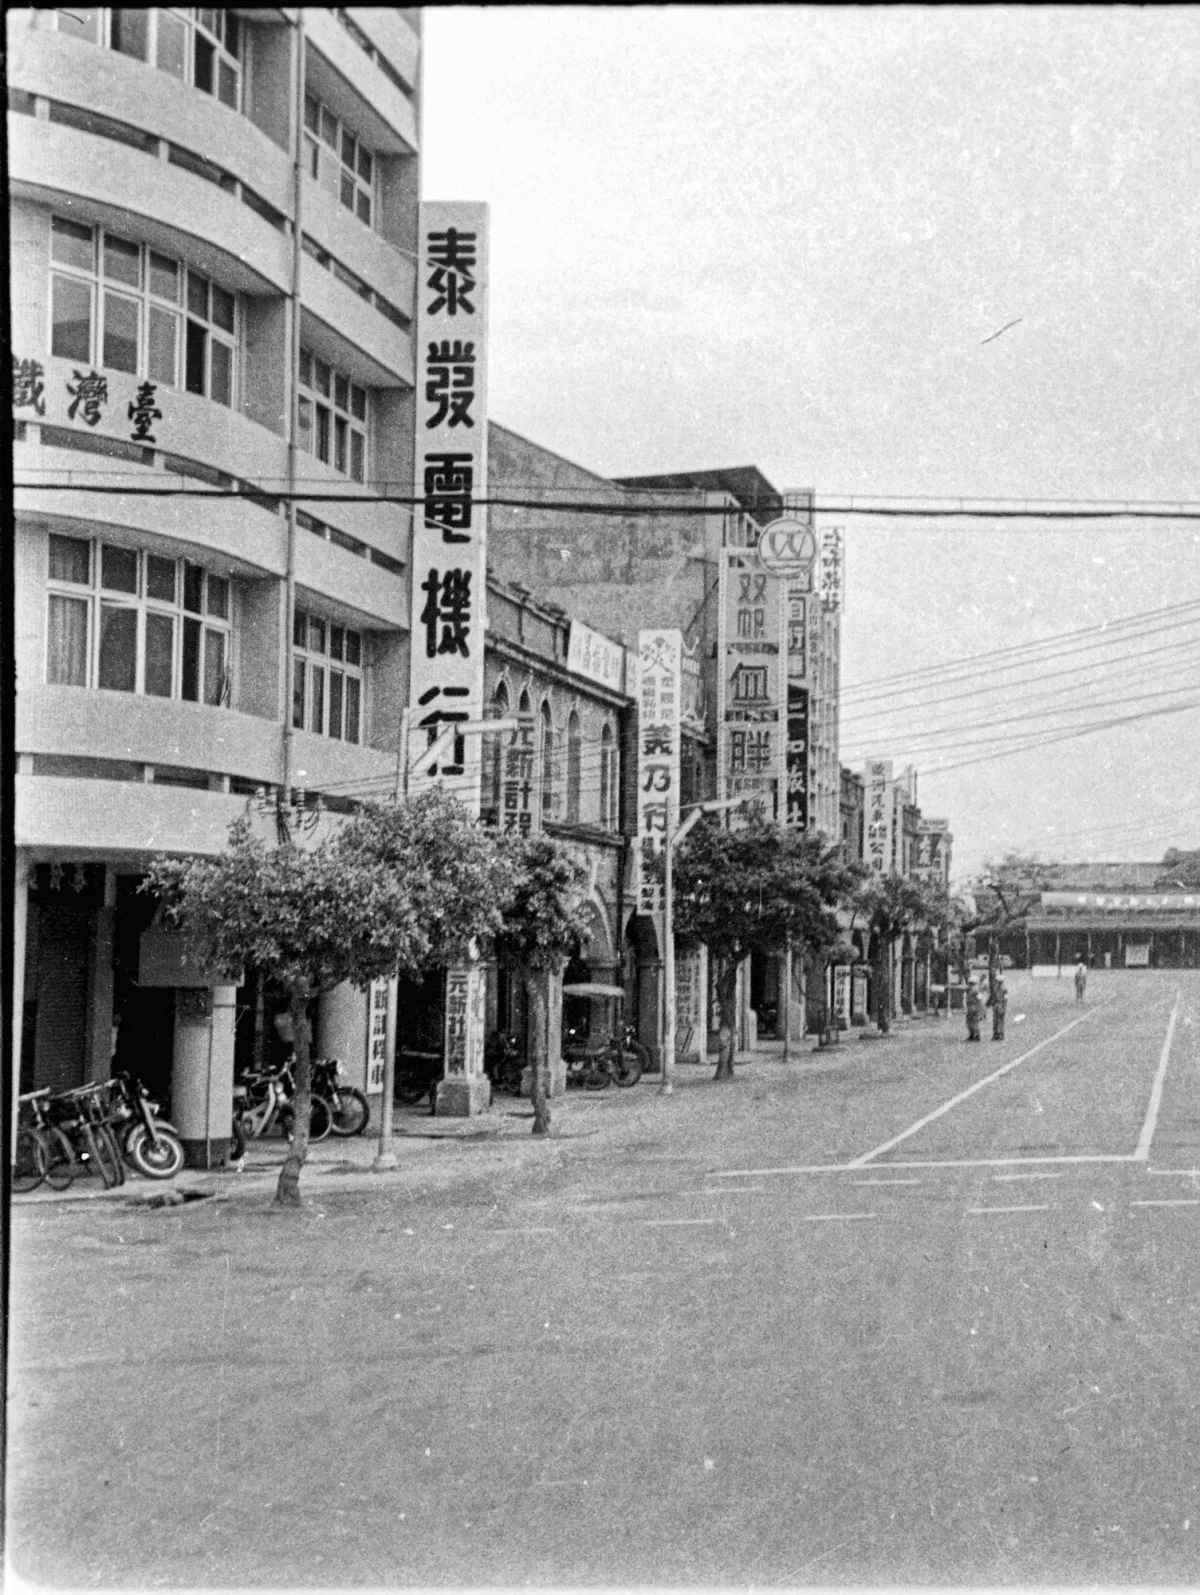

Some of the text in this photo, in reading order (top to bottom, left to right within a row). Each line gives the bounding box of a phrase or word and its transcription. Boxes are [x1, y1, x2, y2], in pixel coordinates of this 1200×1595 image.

[418, 227, 476, 776] 泰發電機行
